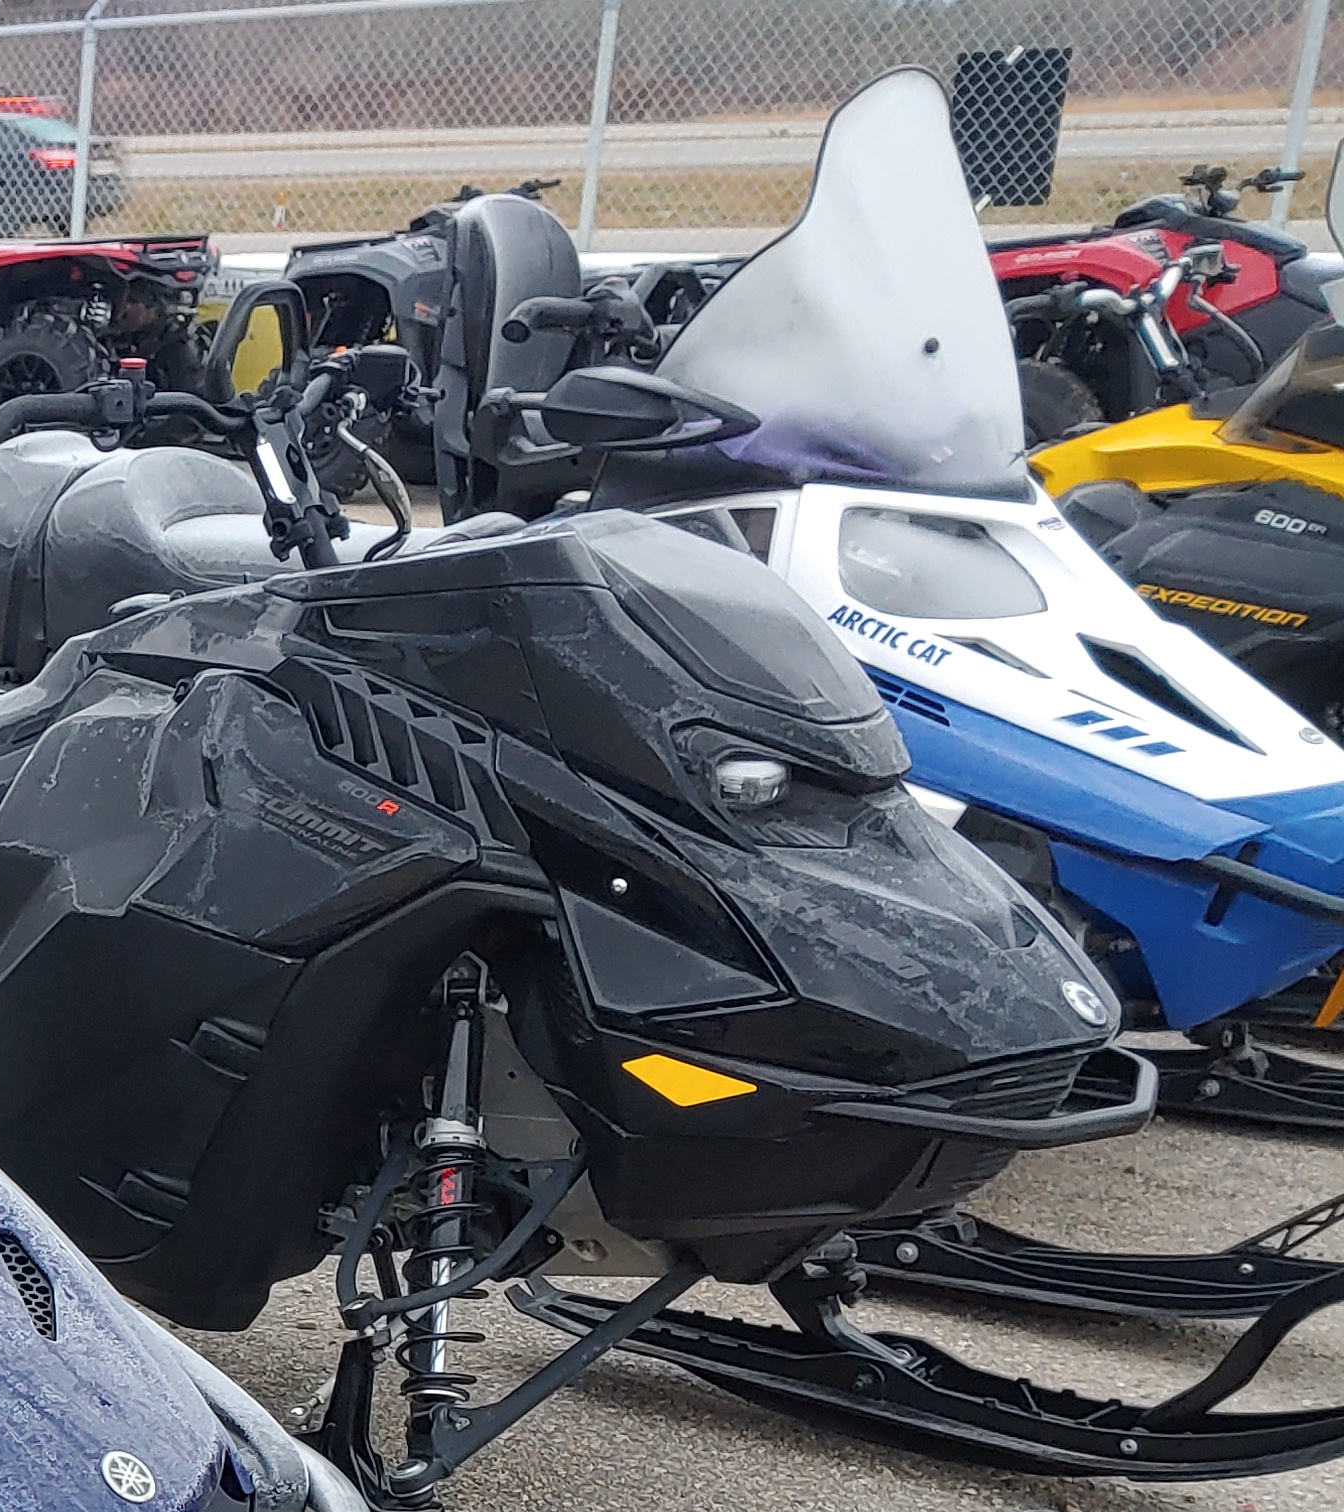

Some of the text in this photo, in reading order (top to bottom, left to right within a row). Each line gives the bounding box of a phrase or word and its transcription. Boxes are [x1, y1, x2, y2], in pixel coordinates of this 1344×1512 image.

[826, 605, 953, 666] ARCTIC CAT
[1135, 583, 1309, 628] EXPEDITION
[239, 788, 387, 852] SUMMIT
